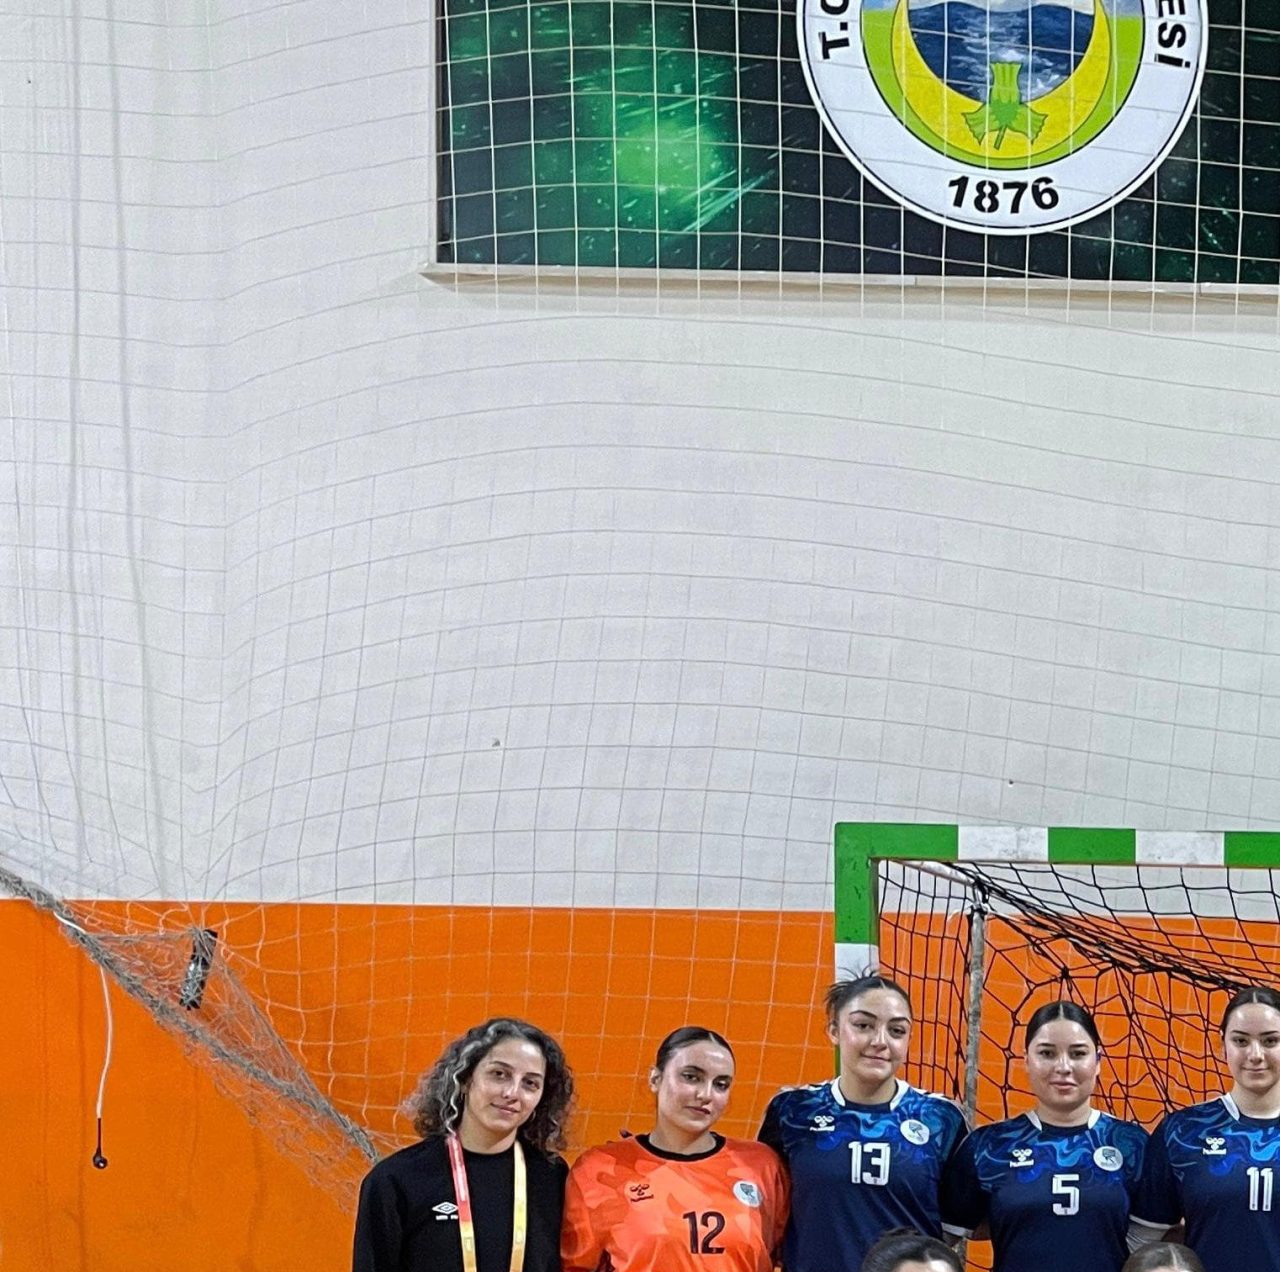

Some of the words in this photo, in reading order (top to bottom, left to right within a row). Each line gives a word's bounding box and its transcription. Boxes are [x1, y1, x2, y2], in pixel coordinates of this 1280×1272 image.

[947, 175, 1060, 214] 1876
[848, 1141, 890, 1186] 13
[1052, 1173, 1080, 1215] 5
[1246, 1166, 1274, 1211] 11
[682, 1210, 726, 1254] 12
